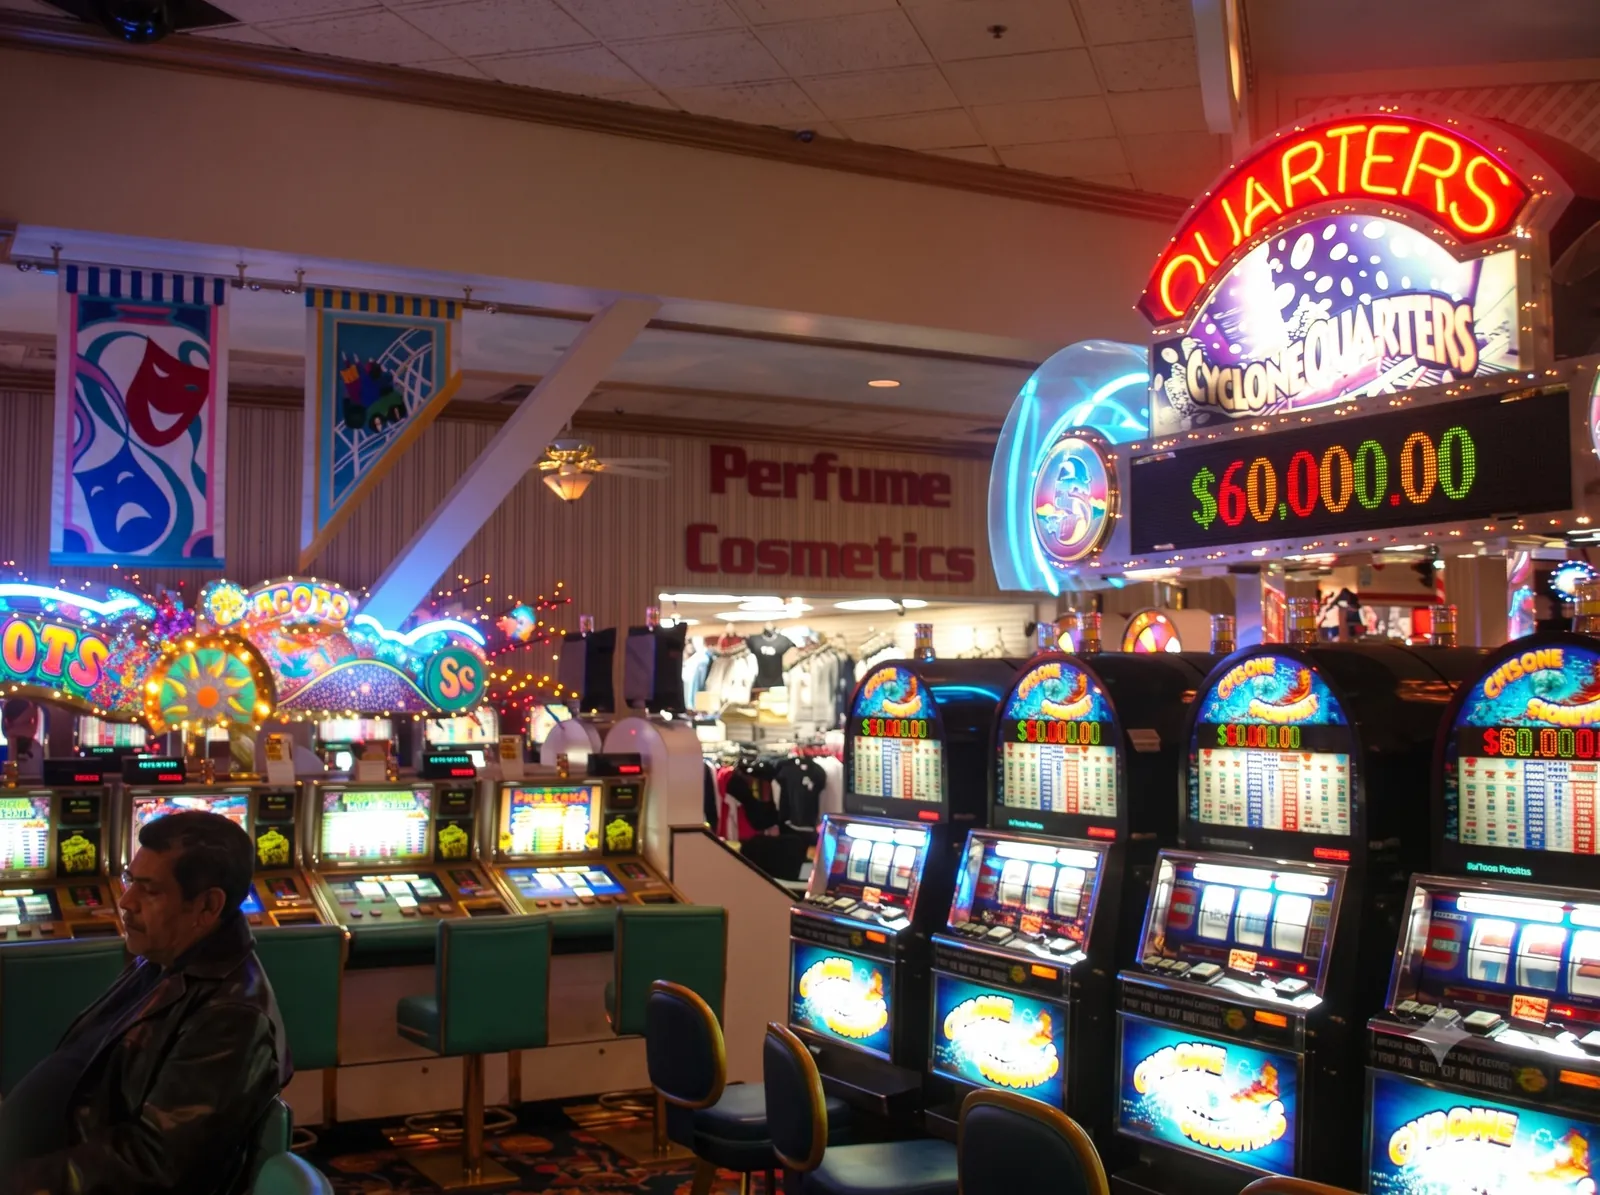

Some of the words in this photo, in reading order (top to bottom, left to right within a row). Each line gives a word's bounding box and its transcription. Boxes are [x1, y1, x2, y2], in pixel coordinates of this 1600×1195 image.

[1160, 124, 1511, 317] QUARTERS
[1186, 343, 1306, 410] CYCLONE
[1303, 294, 1478, 388] QUARTERS
[709, 444, 952, 508] Perfume
[1191, 425, 1476, 530] $60,000.00
[685, 522, 976, 584] Cosmetics
